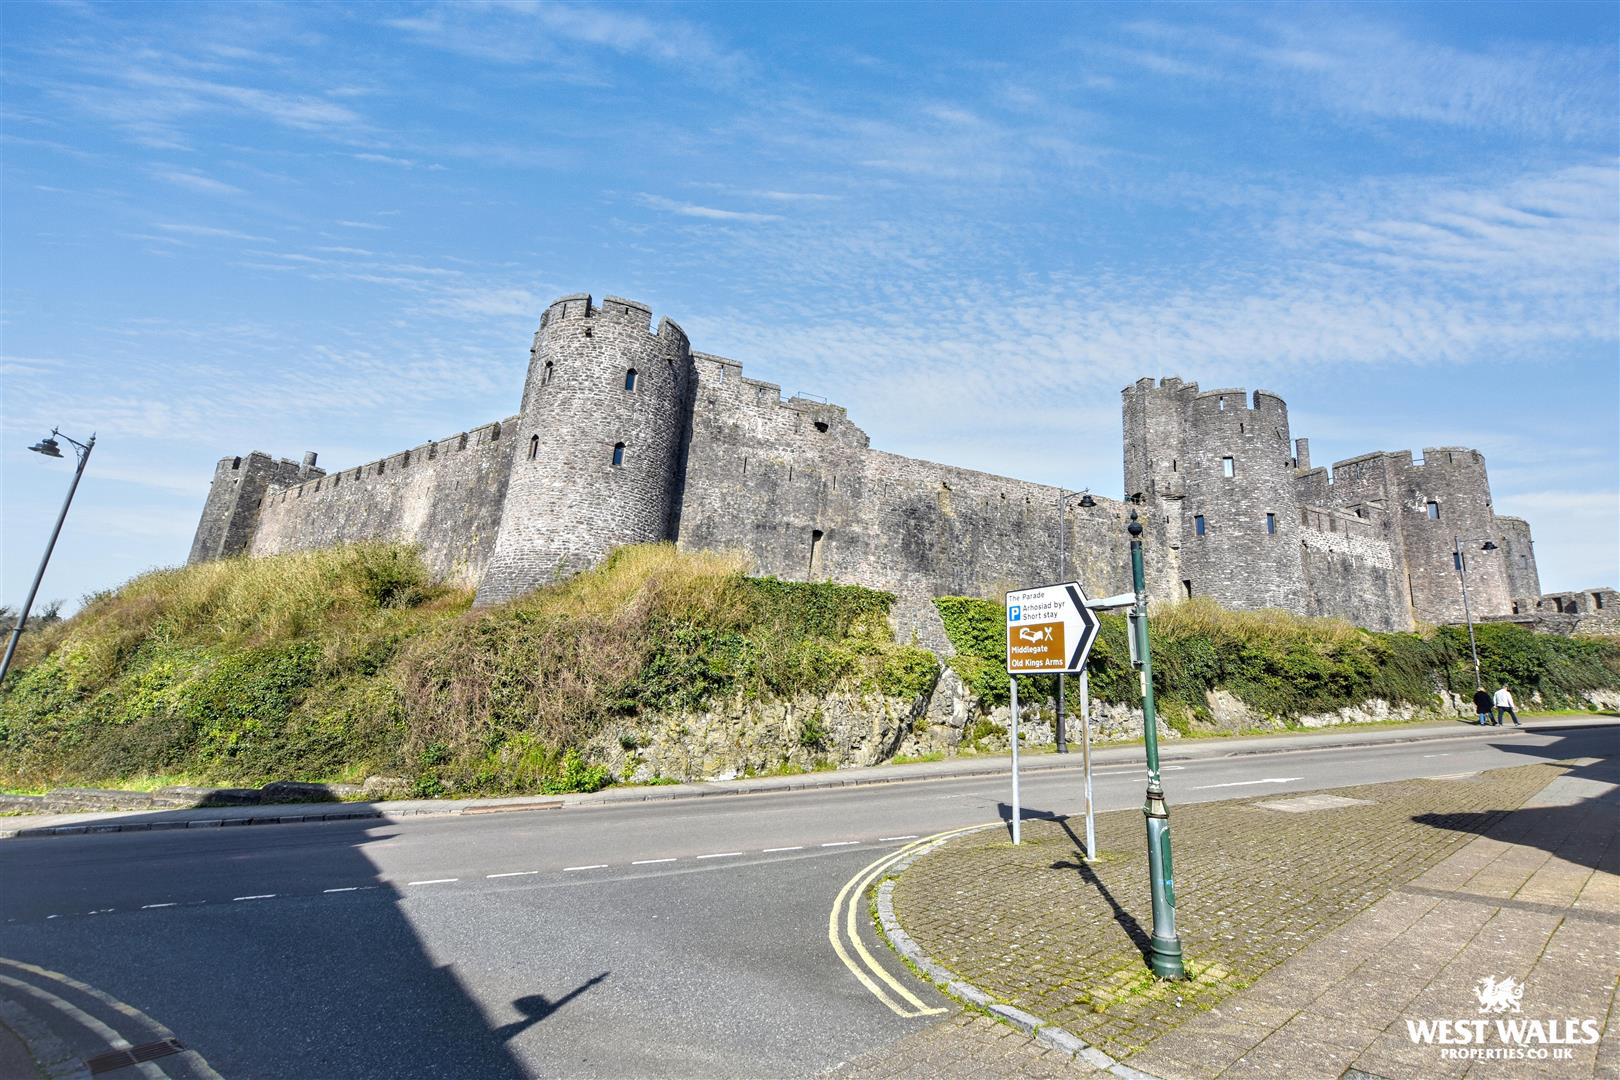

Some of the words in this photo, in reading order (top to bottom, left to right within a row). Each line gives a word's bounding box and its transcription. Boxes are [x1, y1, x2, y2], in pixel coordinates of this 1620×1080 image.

[1022, 592, 1045, 600] Parade
[1023, 602, 1052, 611] Arhosiad
[1011, 608, 1019, 620] P
[1023, 612, 1041, 620] Short
[1011, 645, 1048, 654] Middlegate
[1011, 659, 1023, 667] Old
[1025, 659, 1043, 667] Kings
[1045, 658, 1063, 666] Arms
